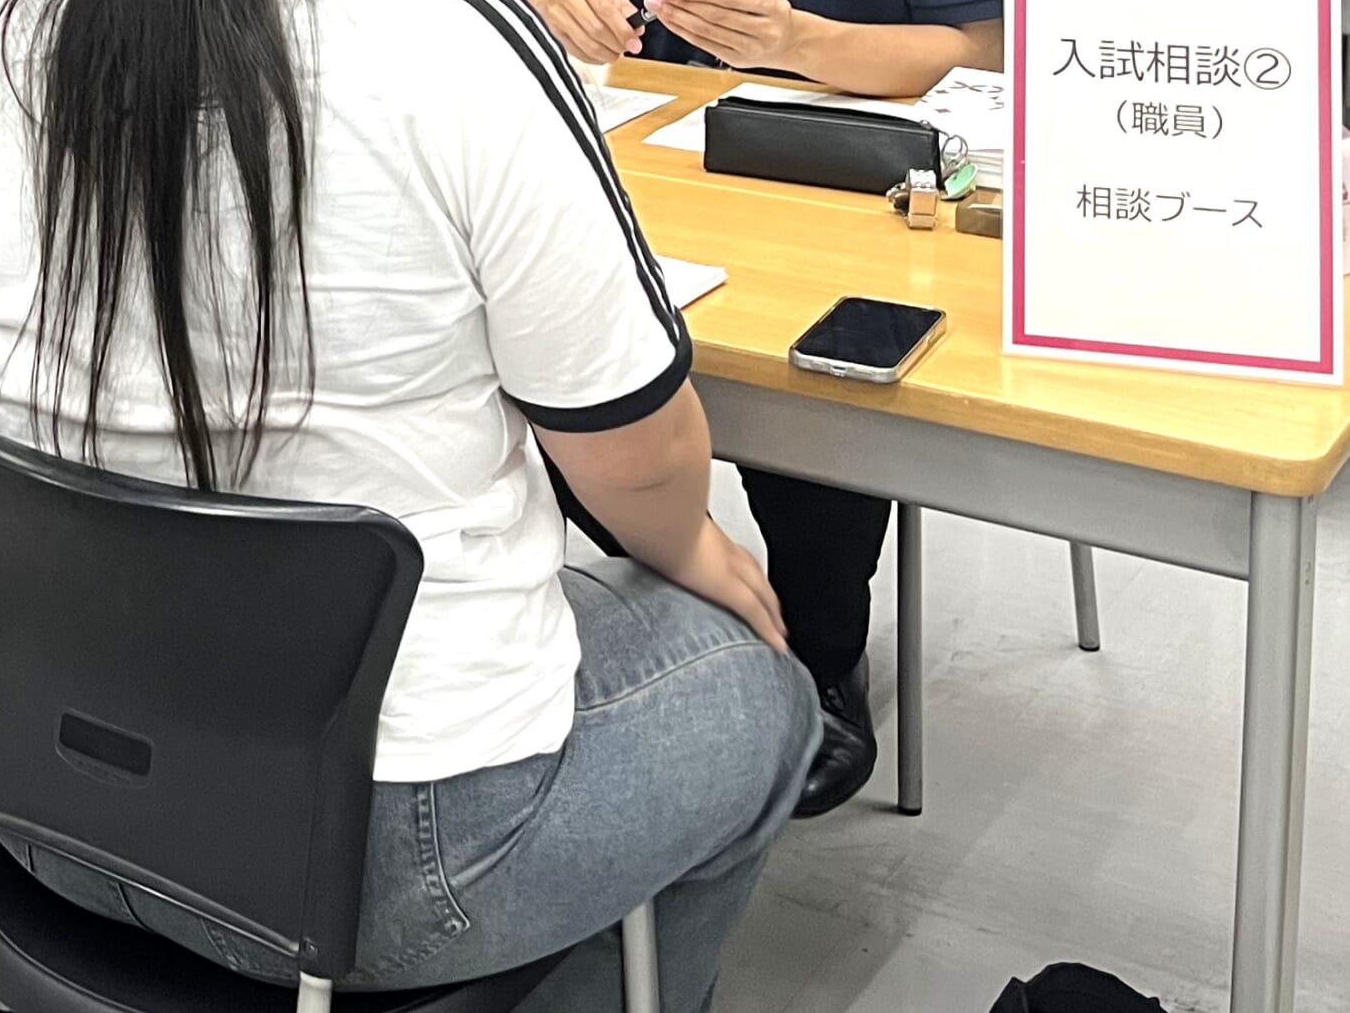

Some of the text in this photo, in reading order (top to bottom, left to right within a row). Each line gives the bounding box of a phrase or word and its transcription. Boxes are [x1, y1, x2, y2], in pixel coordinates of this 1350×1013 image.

[1053, 38, 1292, 91] 入試相談②
[1116, 99, 1223, 140] （職員）
[1076, 183, 1263, 228] 相談ブース
